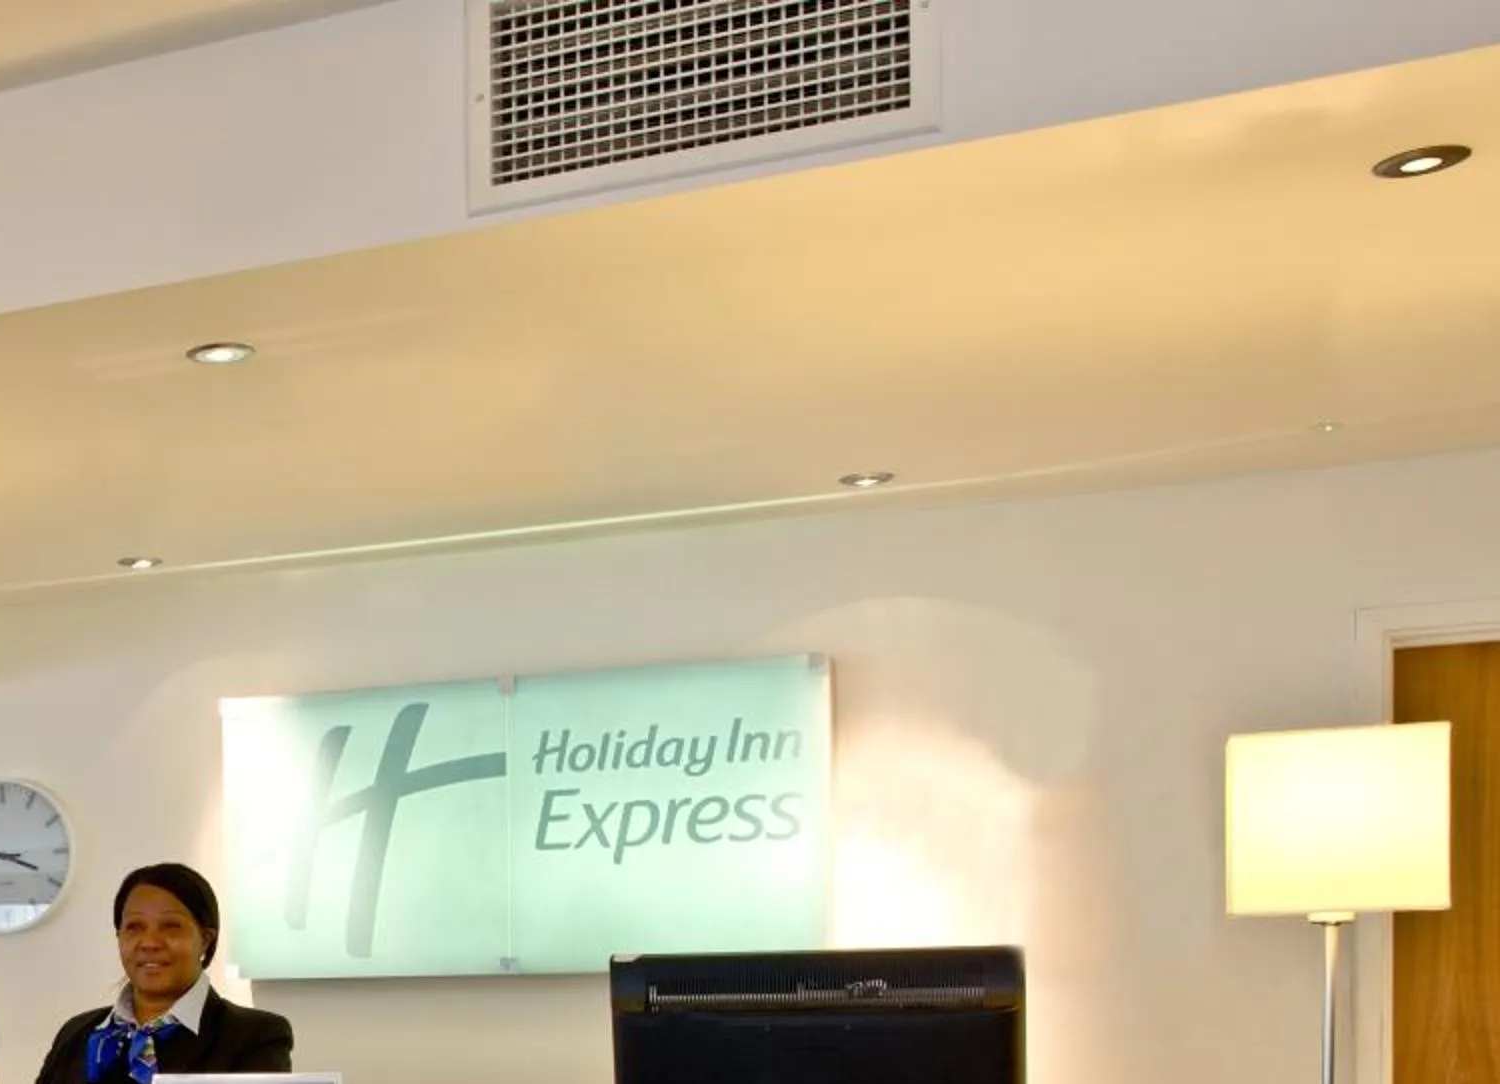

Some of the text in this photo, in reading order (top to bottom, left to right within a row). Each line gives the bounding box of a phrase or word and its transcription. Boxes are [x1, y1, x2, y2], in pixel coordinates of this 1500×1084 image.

[531, 716, 803, 777] Holiday Inn
[534, 787, 806, 865] Express
